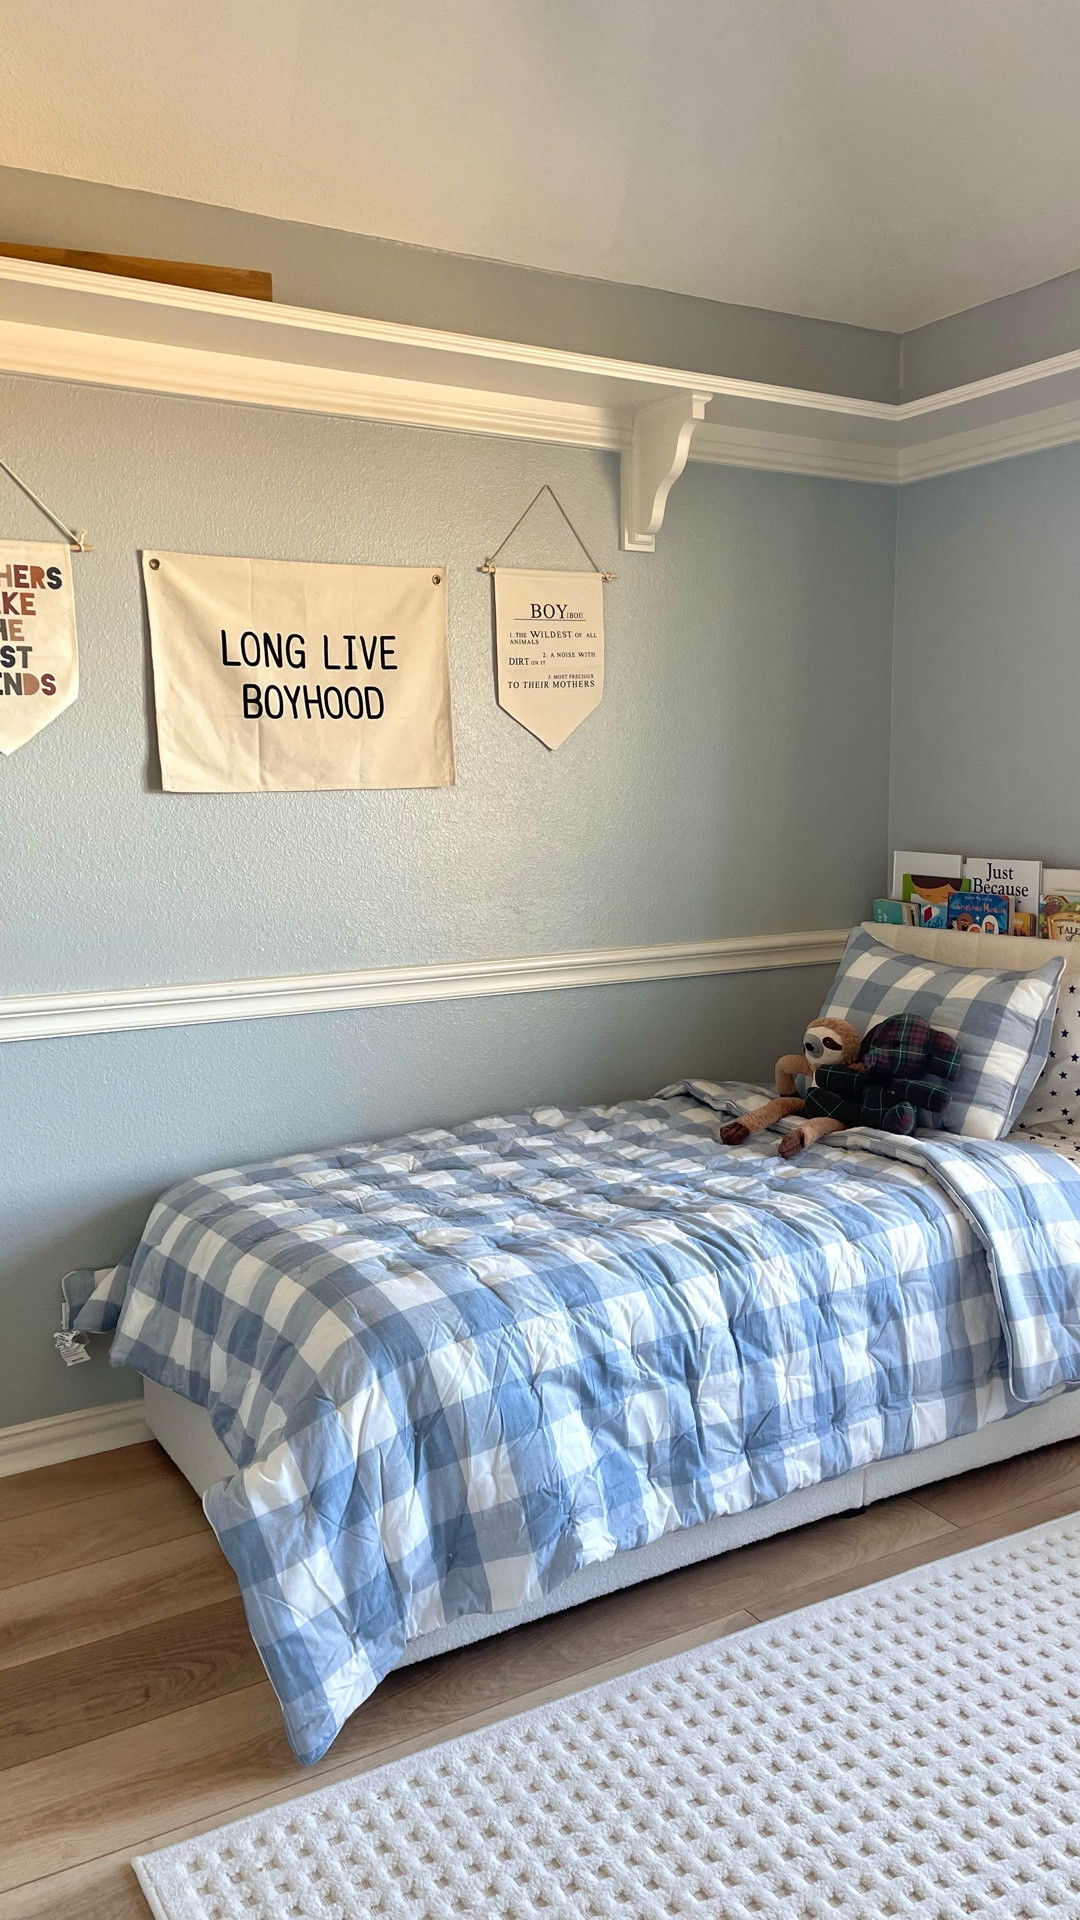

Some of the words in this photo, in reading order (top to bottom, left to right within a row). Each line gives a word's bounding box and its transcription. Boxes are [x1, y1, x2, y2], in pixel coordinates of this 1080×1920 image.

[0, 564, 63, 590] HERS
[0, 591, 37, 616] KE
[530, 603, 568, 619] BOY
[529, 630, 572, 639] WILDEST
[221, 629, 306, 669] LONG
[323, 635, 398, 670] LIVE
[508, 657, 530, 666] DIRT
[0, 672, 57, 696] NDS
[507, 681, 520, 689] TO
[522, 681, 550, 689] THEIR
[552, 680, 595, 689] MOTHERS
[242, 683, 385, 720] BOYHOOD
[986, 862, 1014, 882] Just
[973, 877, 1029, 897] Because
